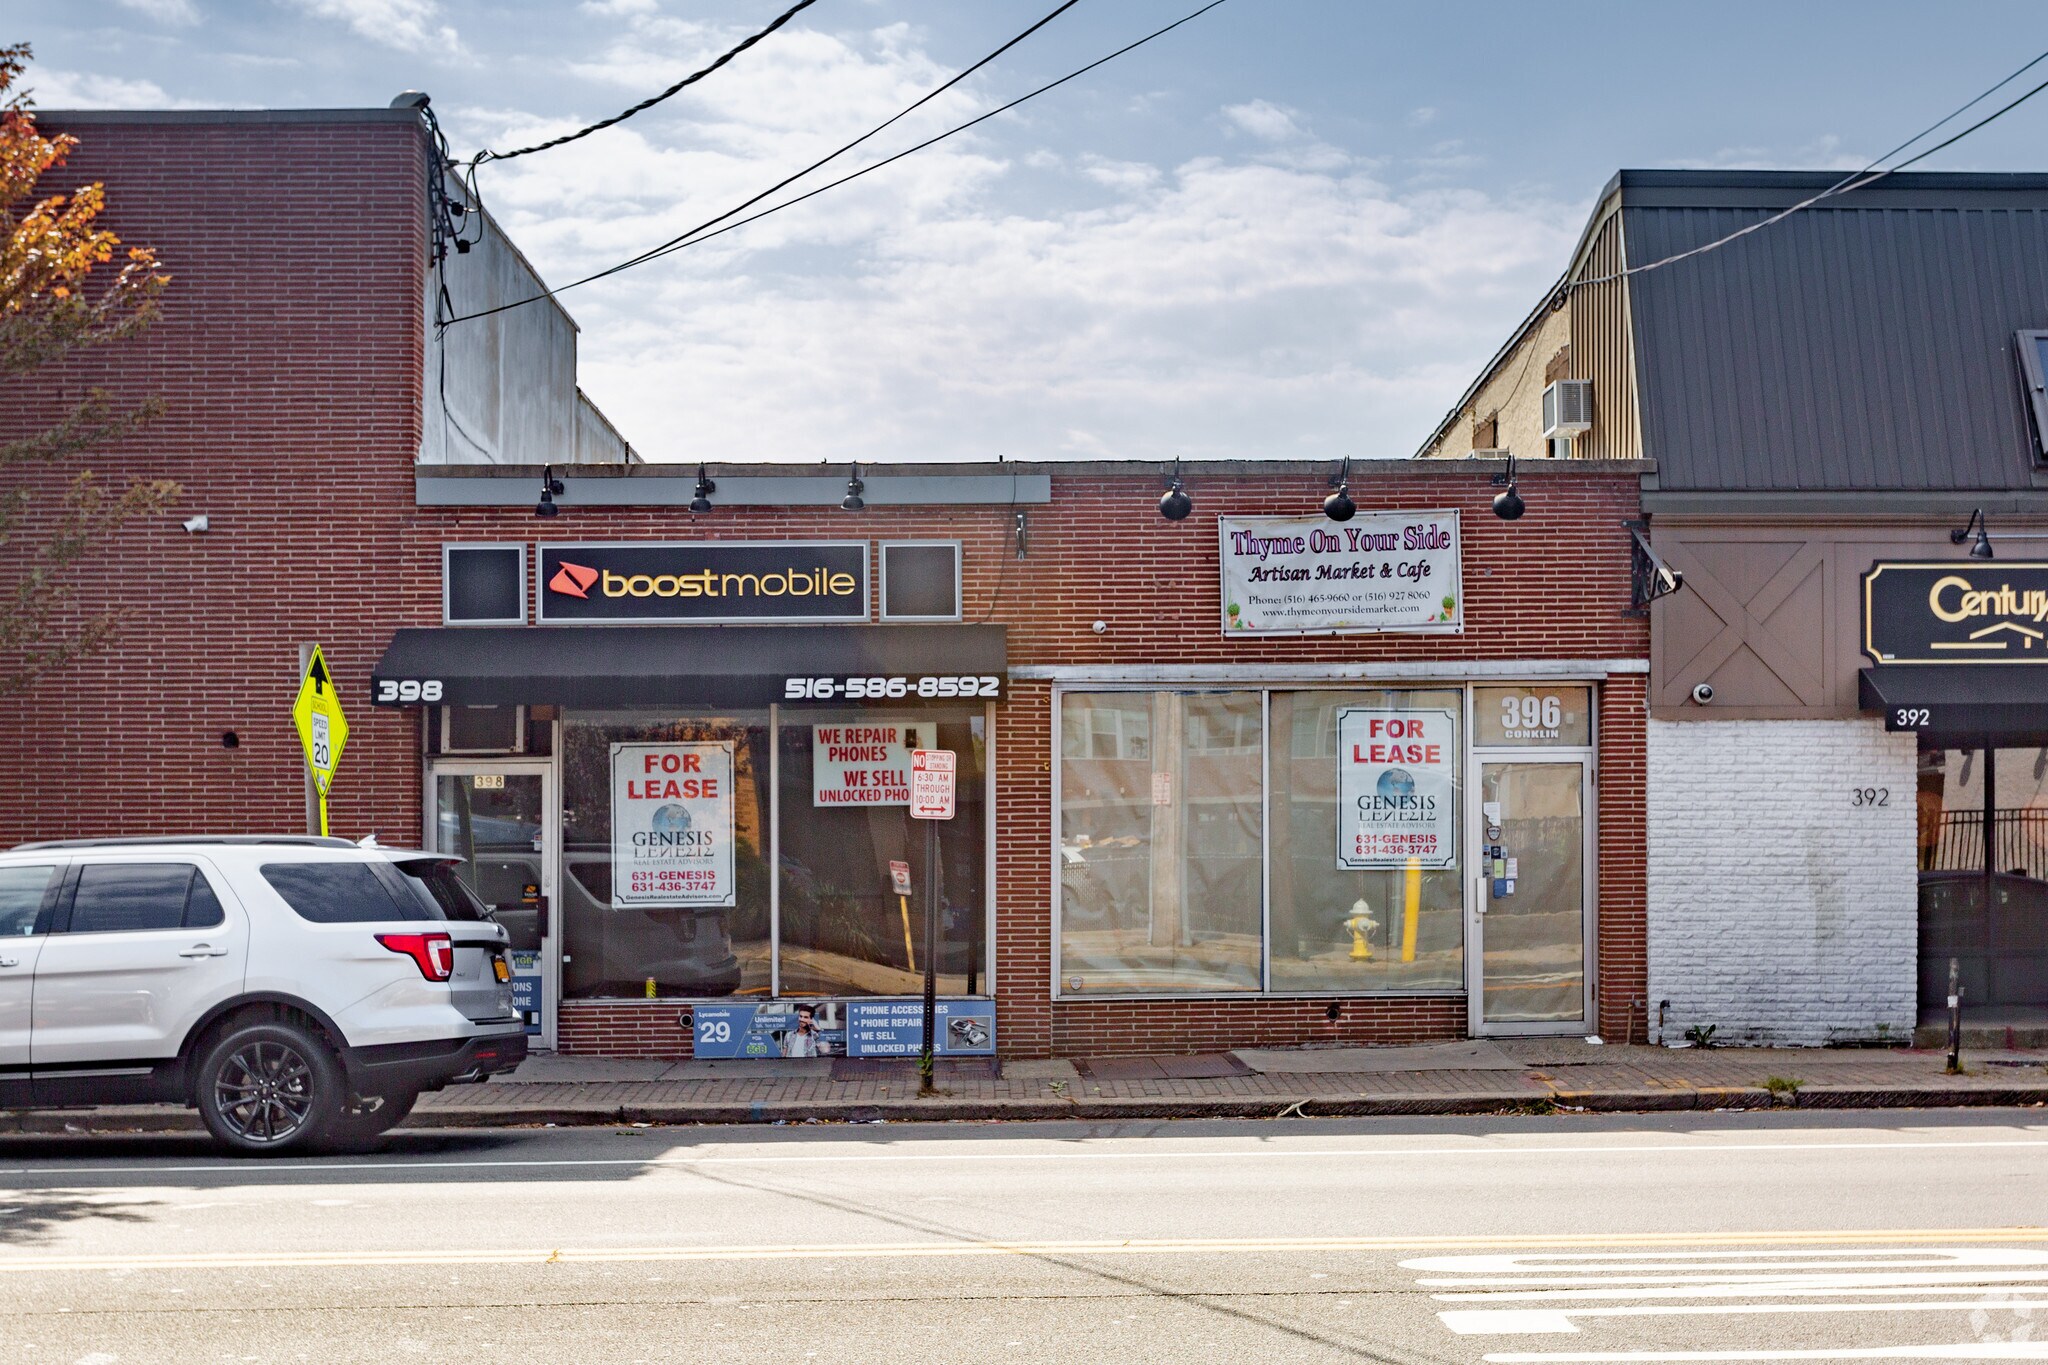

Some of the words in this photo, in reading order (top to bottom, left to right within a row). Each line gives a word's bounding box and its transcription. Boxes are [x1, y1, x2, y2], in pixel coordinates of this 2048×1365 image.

[1231, 530, 1305, 561] Thyme
[1309, 529, 1341, 554] On
[1344, 527, 1399, 552] Your
[1403, 524, 1451, 550] Side
[1248, 565, 1311, 582] Artisan
[1315, 562, 1375, 580] Market
[1380, 563, 1392, 578] &
[1397, 560, 1431, 582] Cafe
[1248, 595, 1281, 605] Phone:
[1284, 594, 1306, 604] (516)
[1308, 593, 1350, 603] 465-9660
[1365, 592, 1387, 602] (516)
[1389, 592, 1405, 600] 927
[1407, 591, 1431, 600] 8060
[1929, 576, 2048, 622] Century
[1262, 604, 1420, 617] www.thymeonyoursidemarket.com
[378, 680, 443, 701] 398
[785, 676, 1000, 698] 516-586-8592
[1501, 696, 1561, 728] 396
[1896, 709, 1930, 726] 392
[313, 717, 328, 730] SPEED
[1369, 719, 1424, 738] FOR
[314, 731, 326, 740] LIMIT
[818, 729, 841, 744] WE
[845, 728, 897, 744] REPAIR
[1505, 729, 1559, 738] CONKLIN
[314, 742, 329, 765] 20
[829, 746, 887, 762] PHONES
[1353, 744, 1441, 764] LEASE
[644, 754, 701, 773] FOR
[913, 754, 926, 768] NO
[476, 776, 502, 788] 398
[844, 771, 868, 787] WE
[872, 770, 907, 786] SELL
[918, 773, 934, 781] 6:30
[938, 774, 949, 782] AM
[628, 779, 718, 799] LEASE
[819, 789, 881, 802] UNLOCKED
[885, 788, 911, 801] PHO
[916, 784, 950, 793] THROUGH
[916, 795, 935, 804] 10:00
[939, 796, 950, 804] AM
[1357, 795, 1436, 810] GENESIS
[1852, 787, 1889, 807] 392
[632, 831, 713, 846] GENESIS
[1356, 834, 1437, 844] 631-GENESIS
[1356, 845, 1437, 855] 631-436-3747
[632, 870, 716, 881] 631-GENESIS
[632, 881, 716, 892] 631-436-3747
[513, 982, 532, 991] ONS
[513, 996, 531, 1006] ONE
[861, 1006, 889, 1014] PHONE
[891, 1005, 949, 1014] ACCESSIES
[861, 1019, 889, 1027] PHONE
[861, 1031, 874, 1040] WE
[876, 1031, 896, 1040] SELL
[861, 1044, 905, 1053] UNLOCKED
[907, 1043, 942, 1052] PHES
